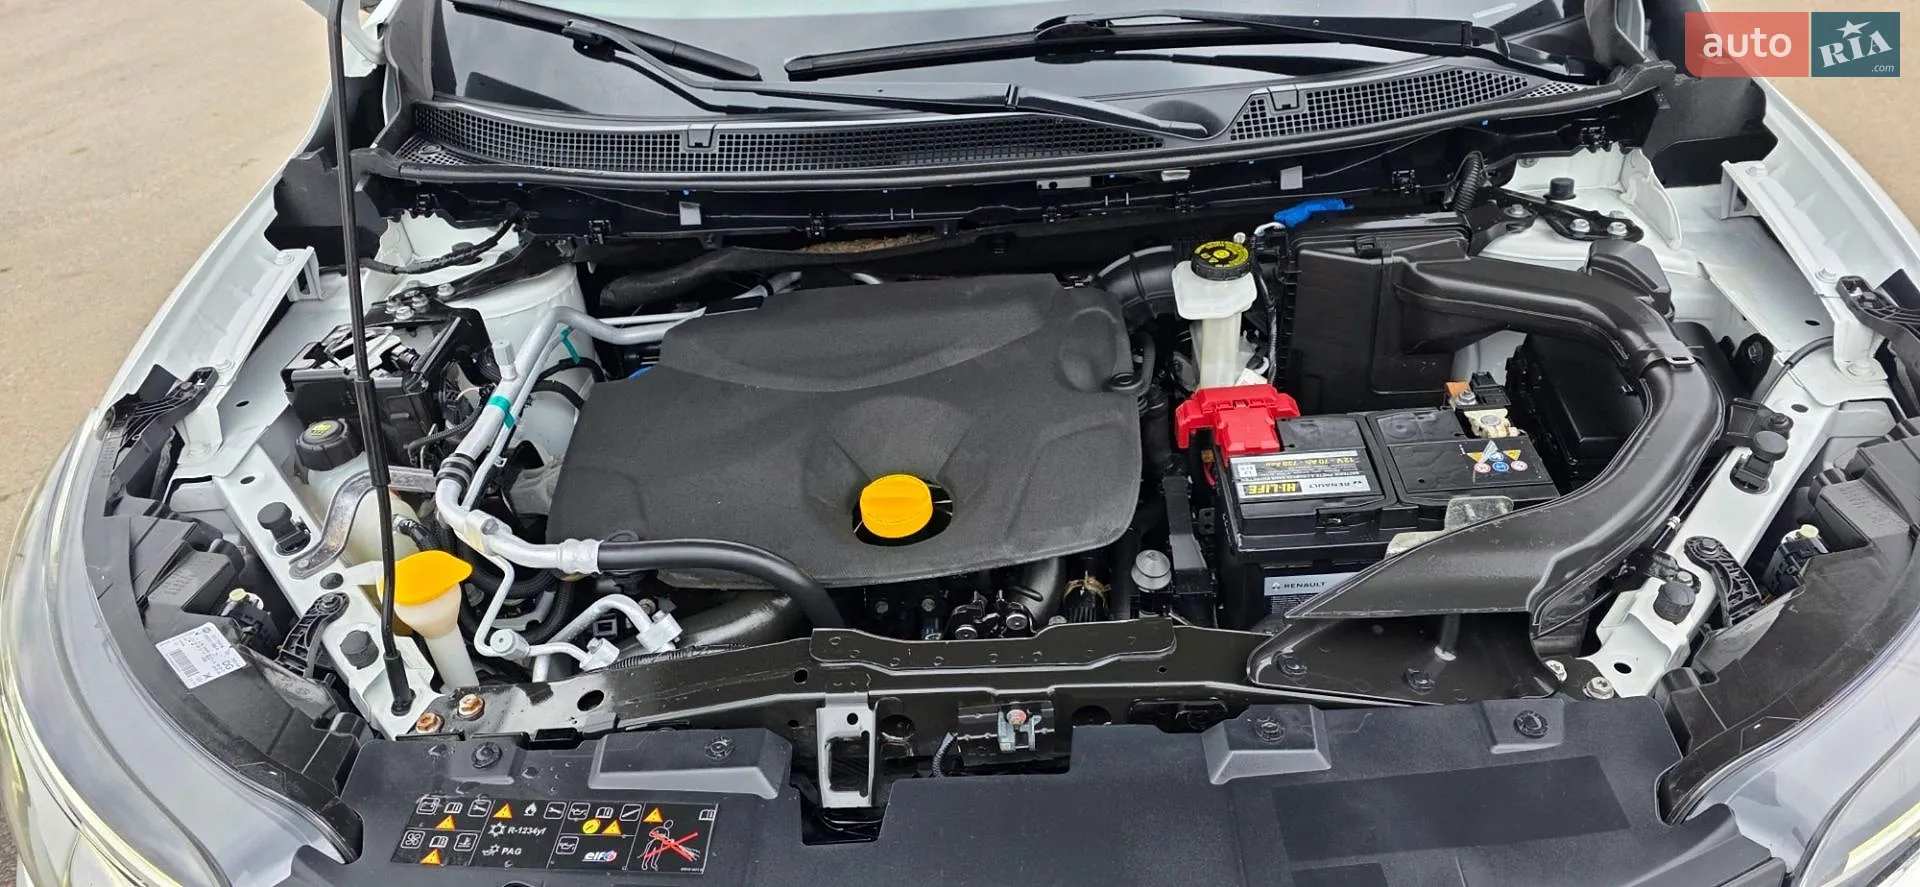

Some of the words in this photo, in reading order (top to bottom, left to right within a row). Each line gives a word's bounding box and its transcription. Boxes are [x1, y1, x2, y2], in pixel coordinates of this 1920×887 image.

[1283, 581, 1326, 589] RENAULT
[507, 826, 547, 836] R-1234yf
[500, 847, 522, 855] PAG
[583, 851, 607, 860] elf
